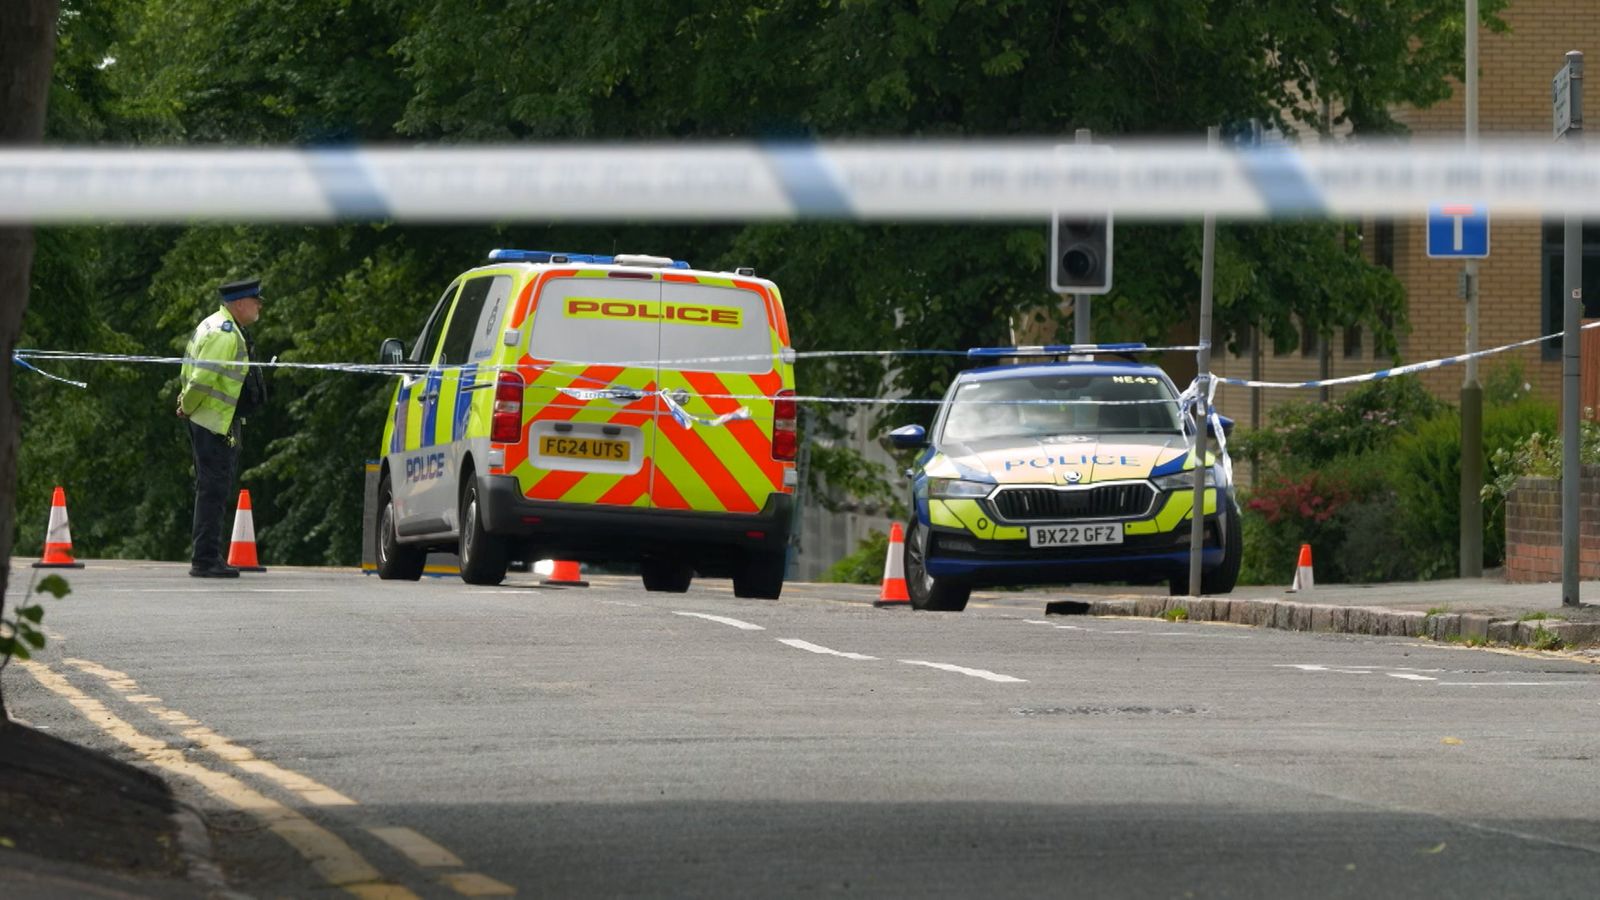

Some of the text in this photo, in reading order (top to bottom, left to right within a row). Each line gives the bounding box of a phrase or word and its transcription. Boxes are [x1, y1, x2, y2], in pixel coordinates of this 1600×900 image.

[568, 300, 739, 325] POLICE
[546, 438, 624, 458] FG24 UTS
[406, 452, 445, 483] POLICE
[1005, 455, 1141, 471] POLICE
[1037, 526, 1116, 545] BX22 GFZ
